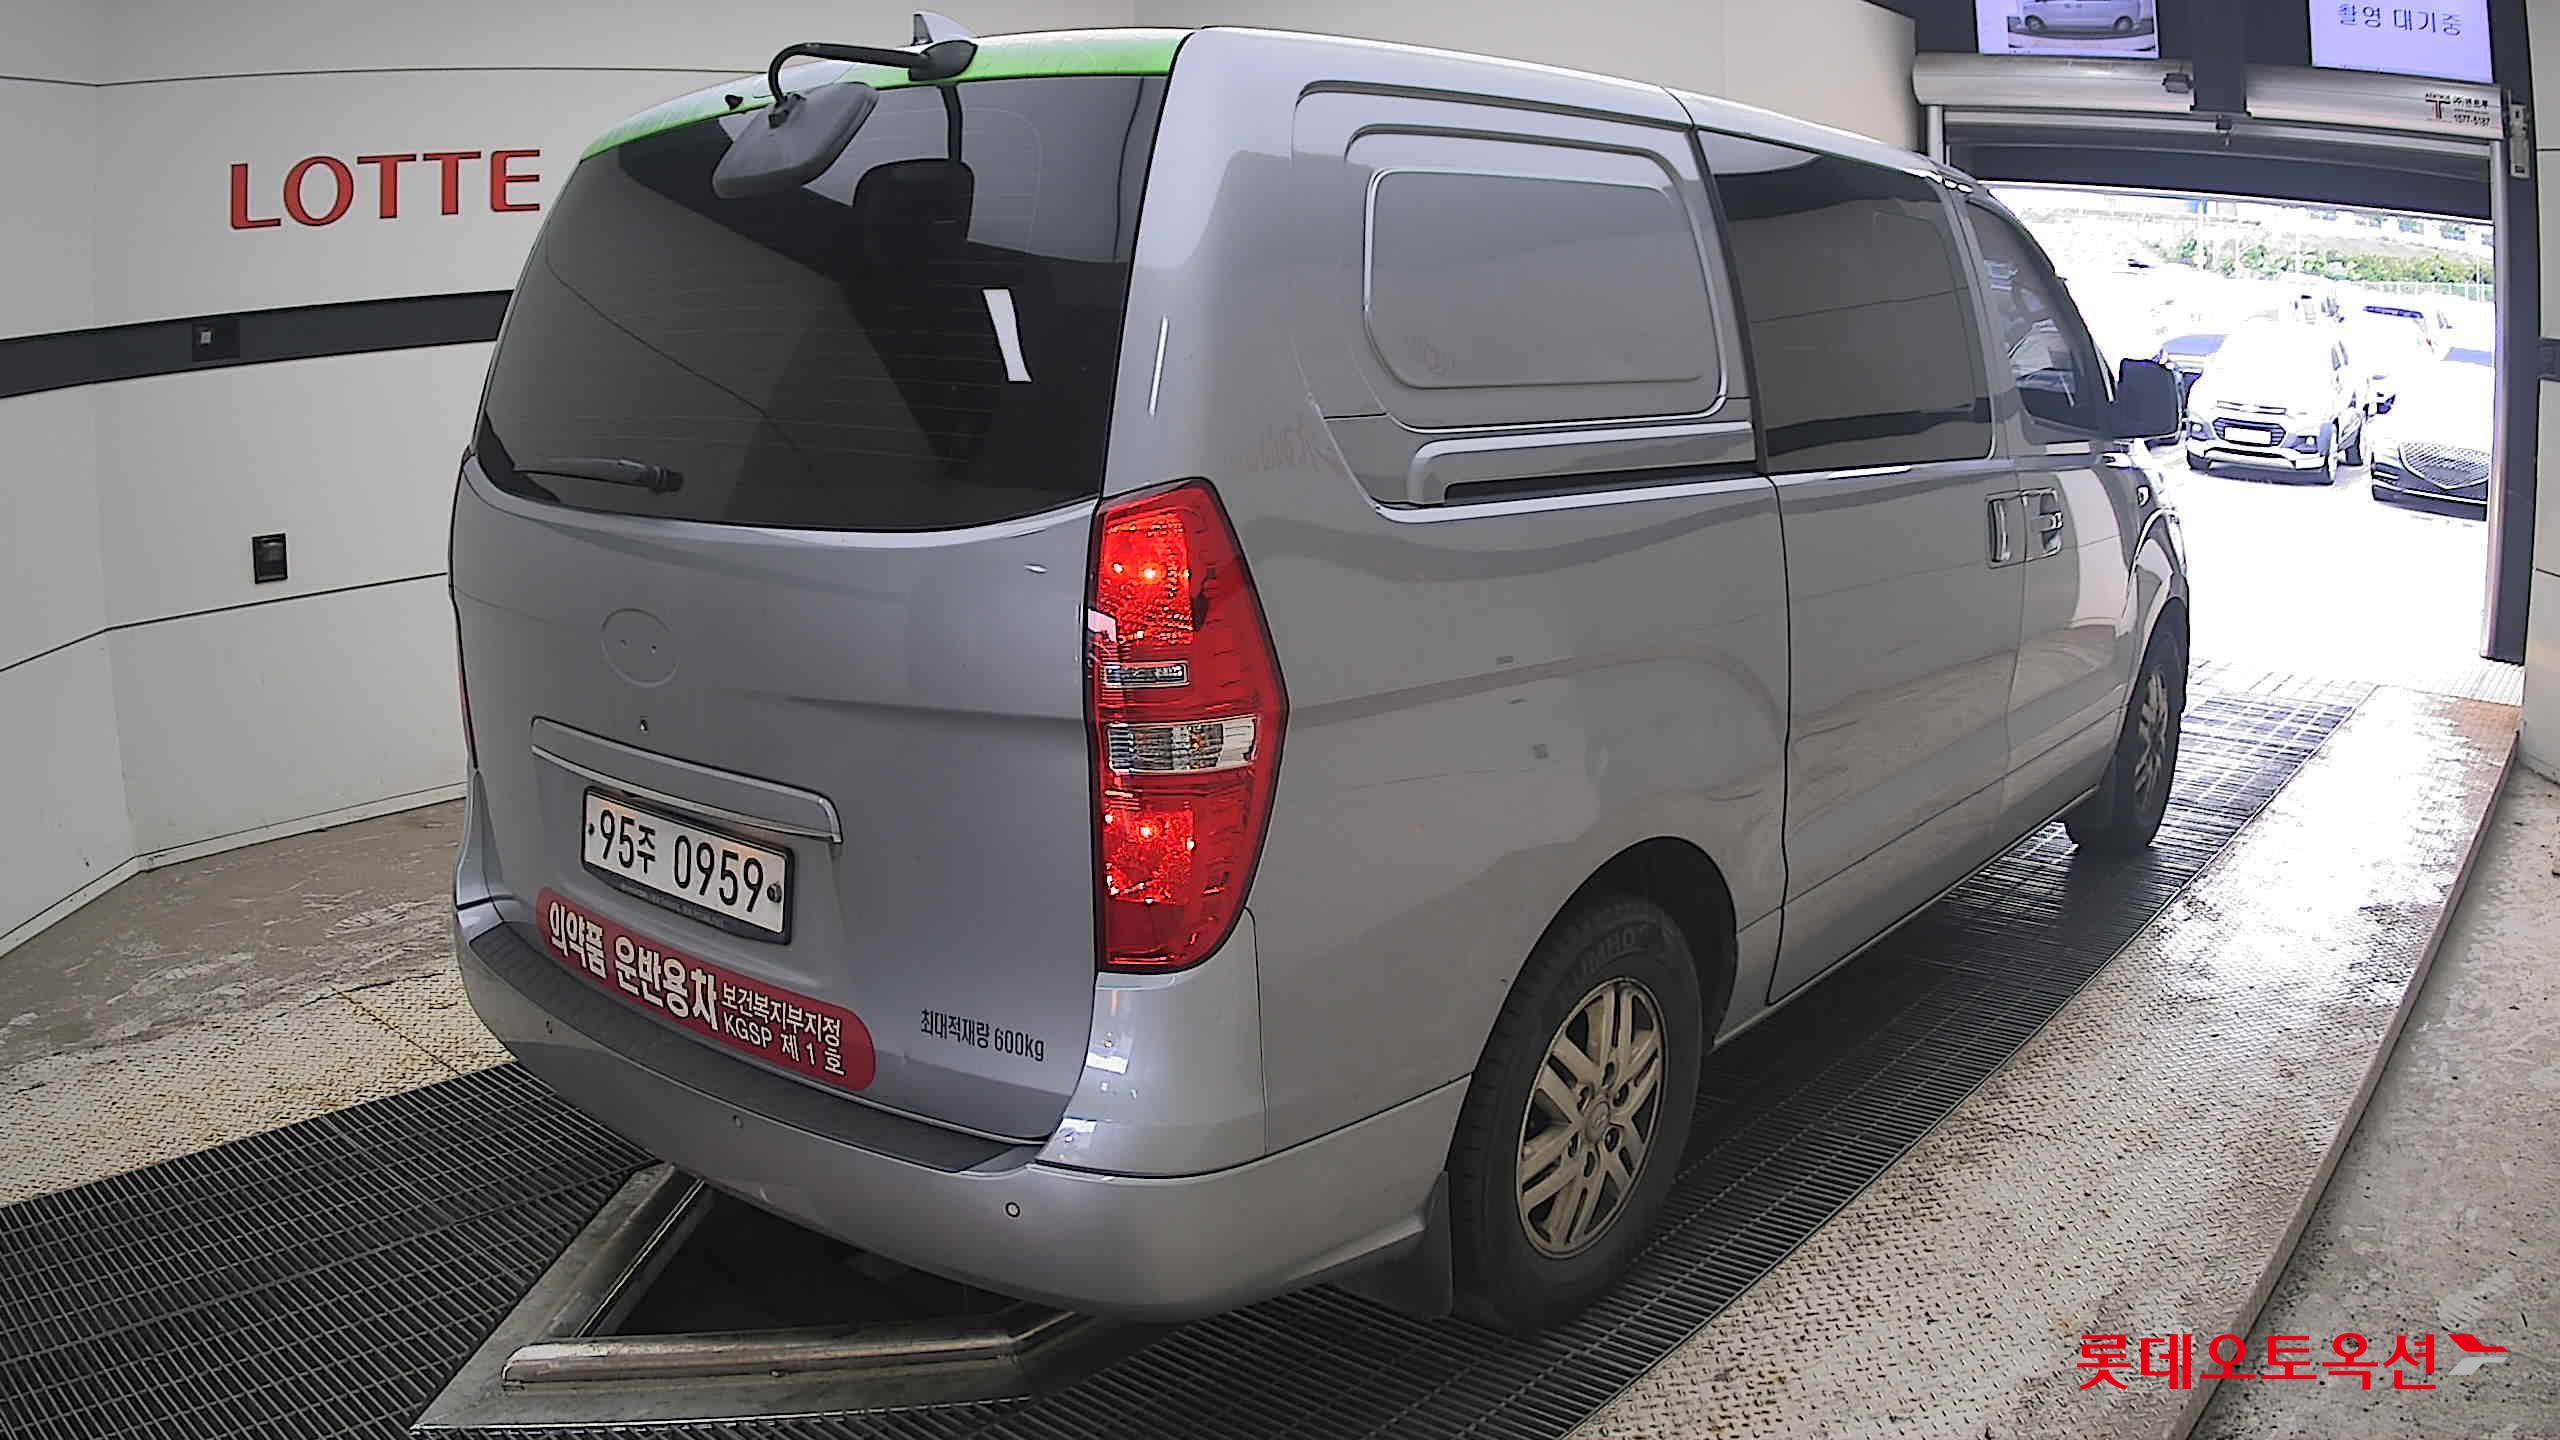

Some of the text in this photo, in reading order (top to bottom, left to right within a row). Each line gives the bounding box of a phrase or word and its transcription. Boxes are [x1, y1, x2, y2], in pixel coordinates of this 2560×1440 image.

[2338, 4, 2461, 36] 촬영 대기중
[230, 149, 541, 230] LOTTE
[599, 808, 656, 875] 95주
[673, 834, 764, 912] 0959
[549, 900, 608, 980] 의약품
[614, 935, 719, 1032] 운반용차
[721, 982, 842, 1048] 보건복지부지정
[722, 1011, 848, 1077] KGSP 제 1 호
[920, 1008, 1045, 1062] 최대적재량 600kg
